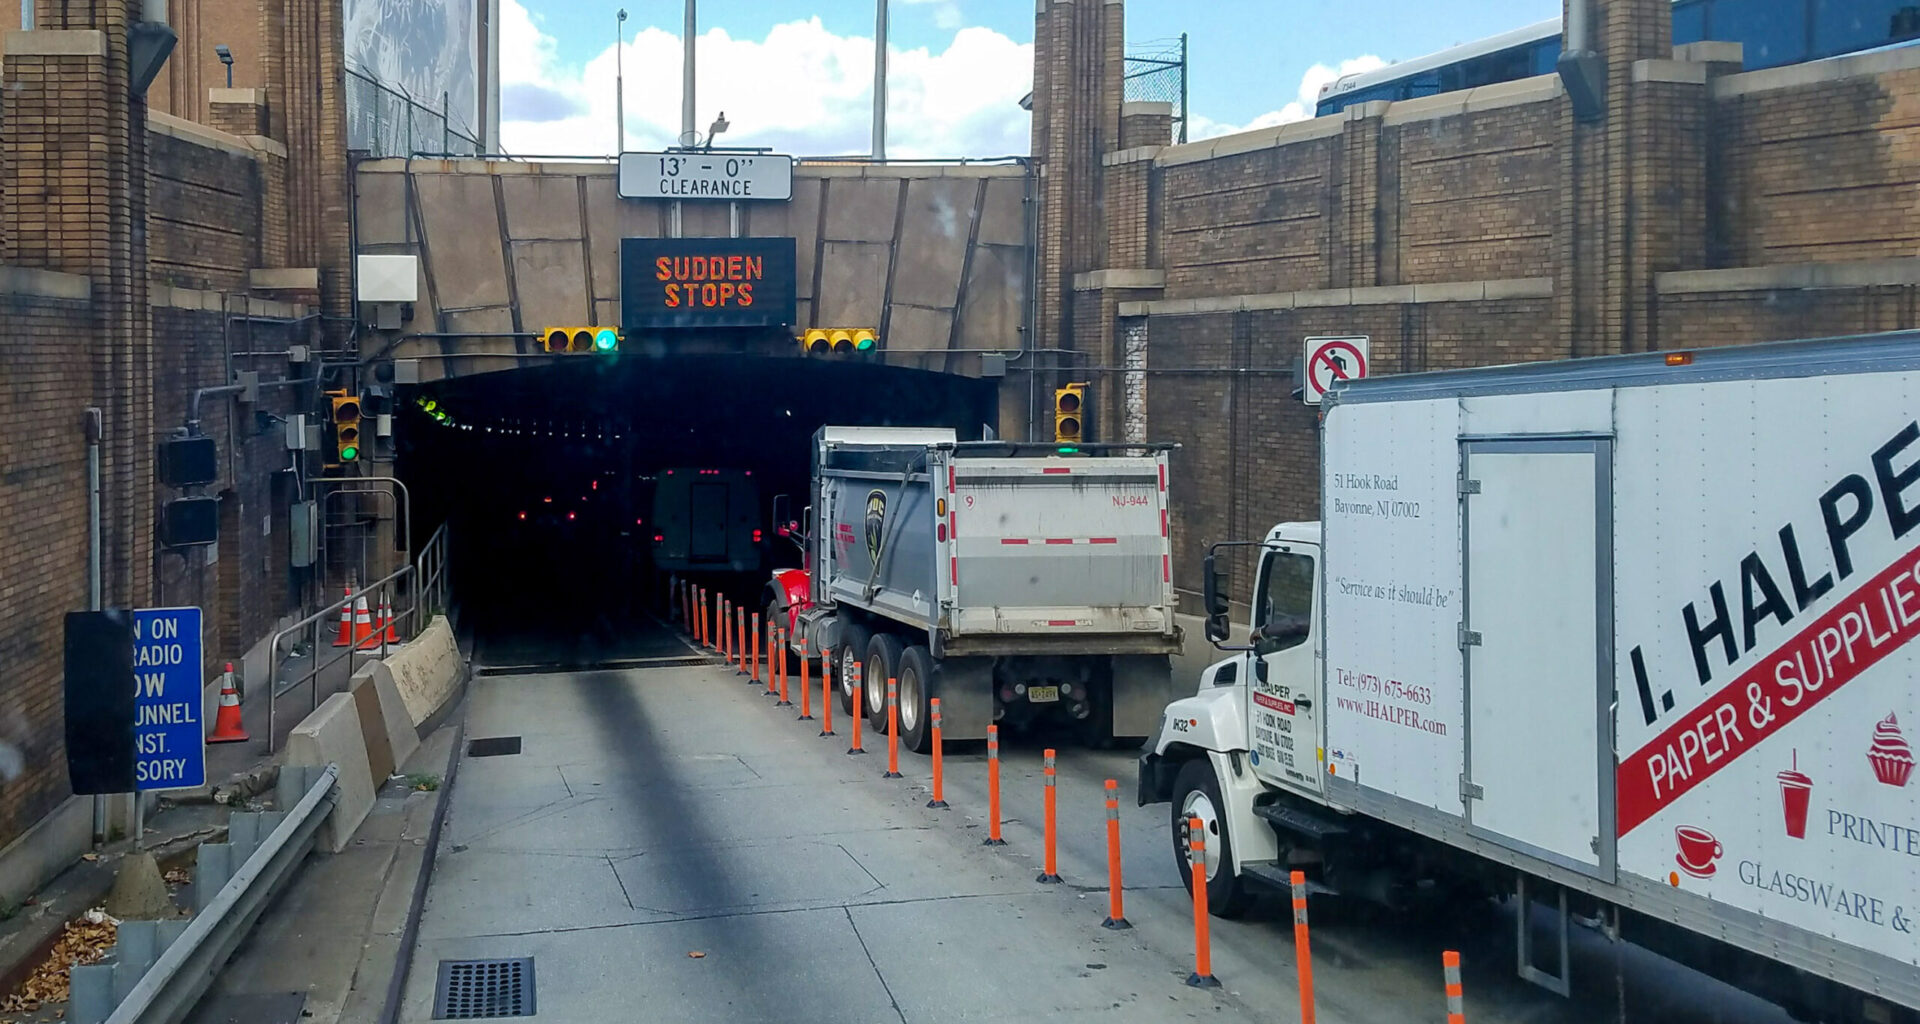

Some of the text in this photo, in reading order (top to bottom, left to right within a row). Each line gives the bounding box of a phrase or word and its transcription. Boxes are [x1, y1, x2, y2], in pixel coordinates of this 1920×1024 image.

[660, 179, 752, 196] CLEARANCE
[655, 256, 763, 281] SUDDEN
[664, 282, 753, 307] STOPS
[1334, 473, 1398, 491] 51 Hook Road
[965, 495, 974, 508] 9
[1112, 495, 1149, 507] NJ-944
[1334, 498, 1420, 519] Bayonne, NJ 07002
[1374, 586, 1386, 600] as
[1388, 582, 1396, 601] it
[1398, 584, 1433, 606] should
[151, 618, 178, 639] ON
[1336, 668, 1432, 706] Tel: (973) 675-6633
[1629, 644, 1676, 727] I.
[134, 702, 197, 727] UNNEL
[1336, 696, 1448, 737] www.IHALPER.com
[1646, 702, 1744, 800] PAPER
[1747, 682, 1776, 729] &
[1738, 860, 1912, 935] GLASSWARE &
